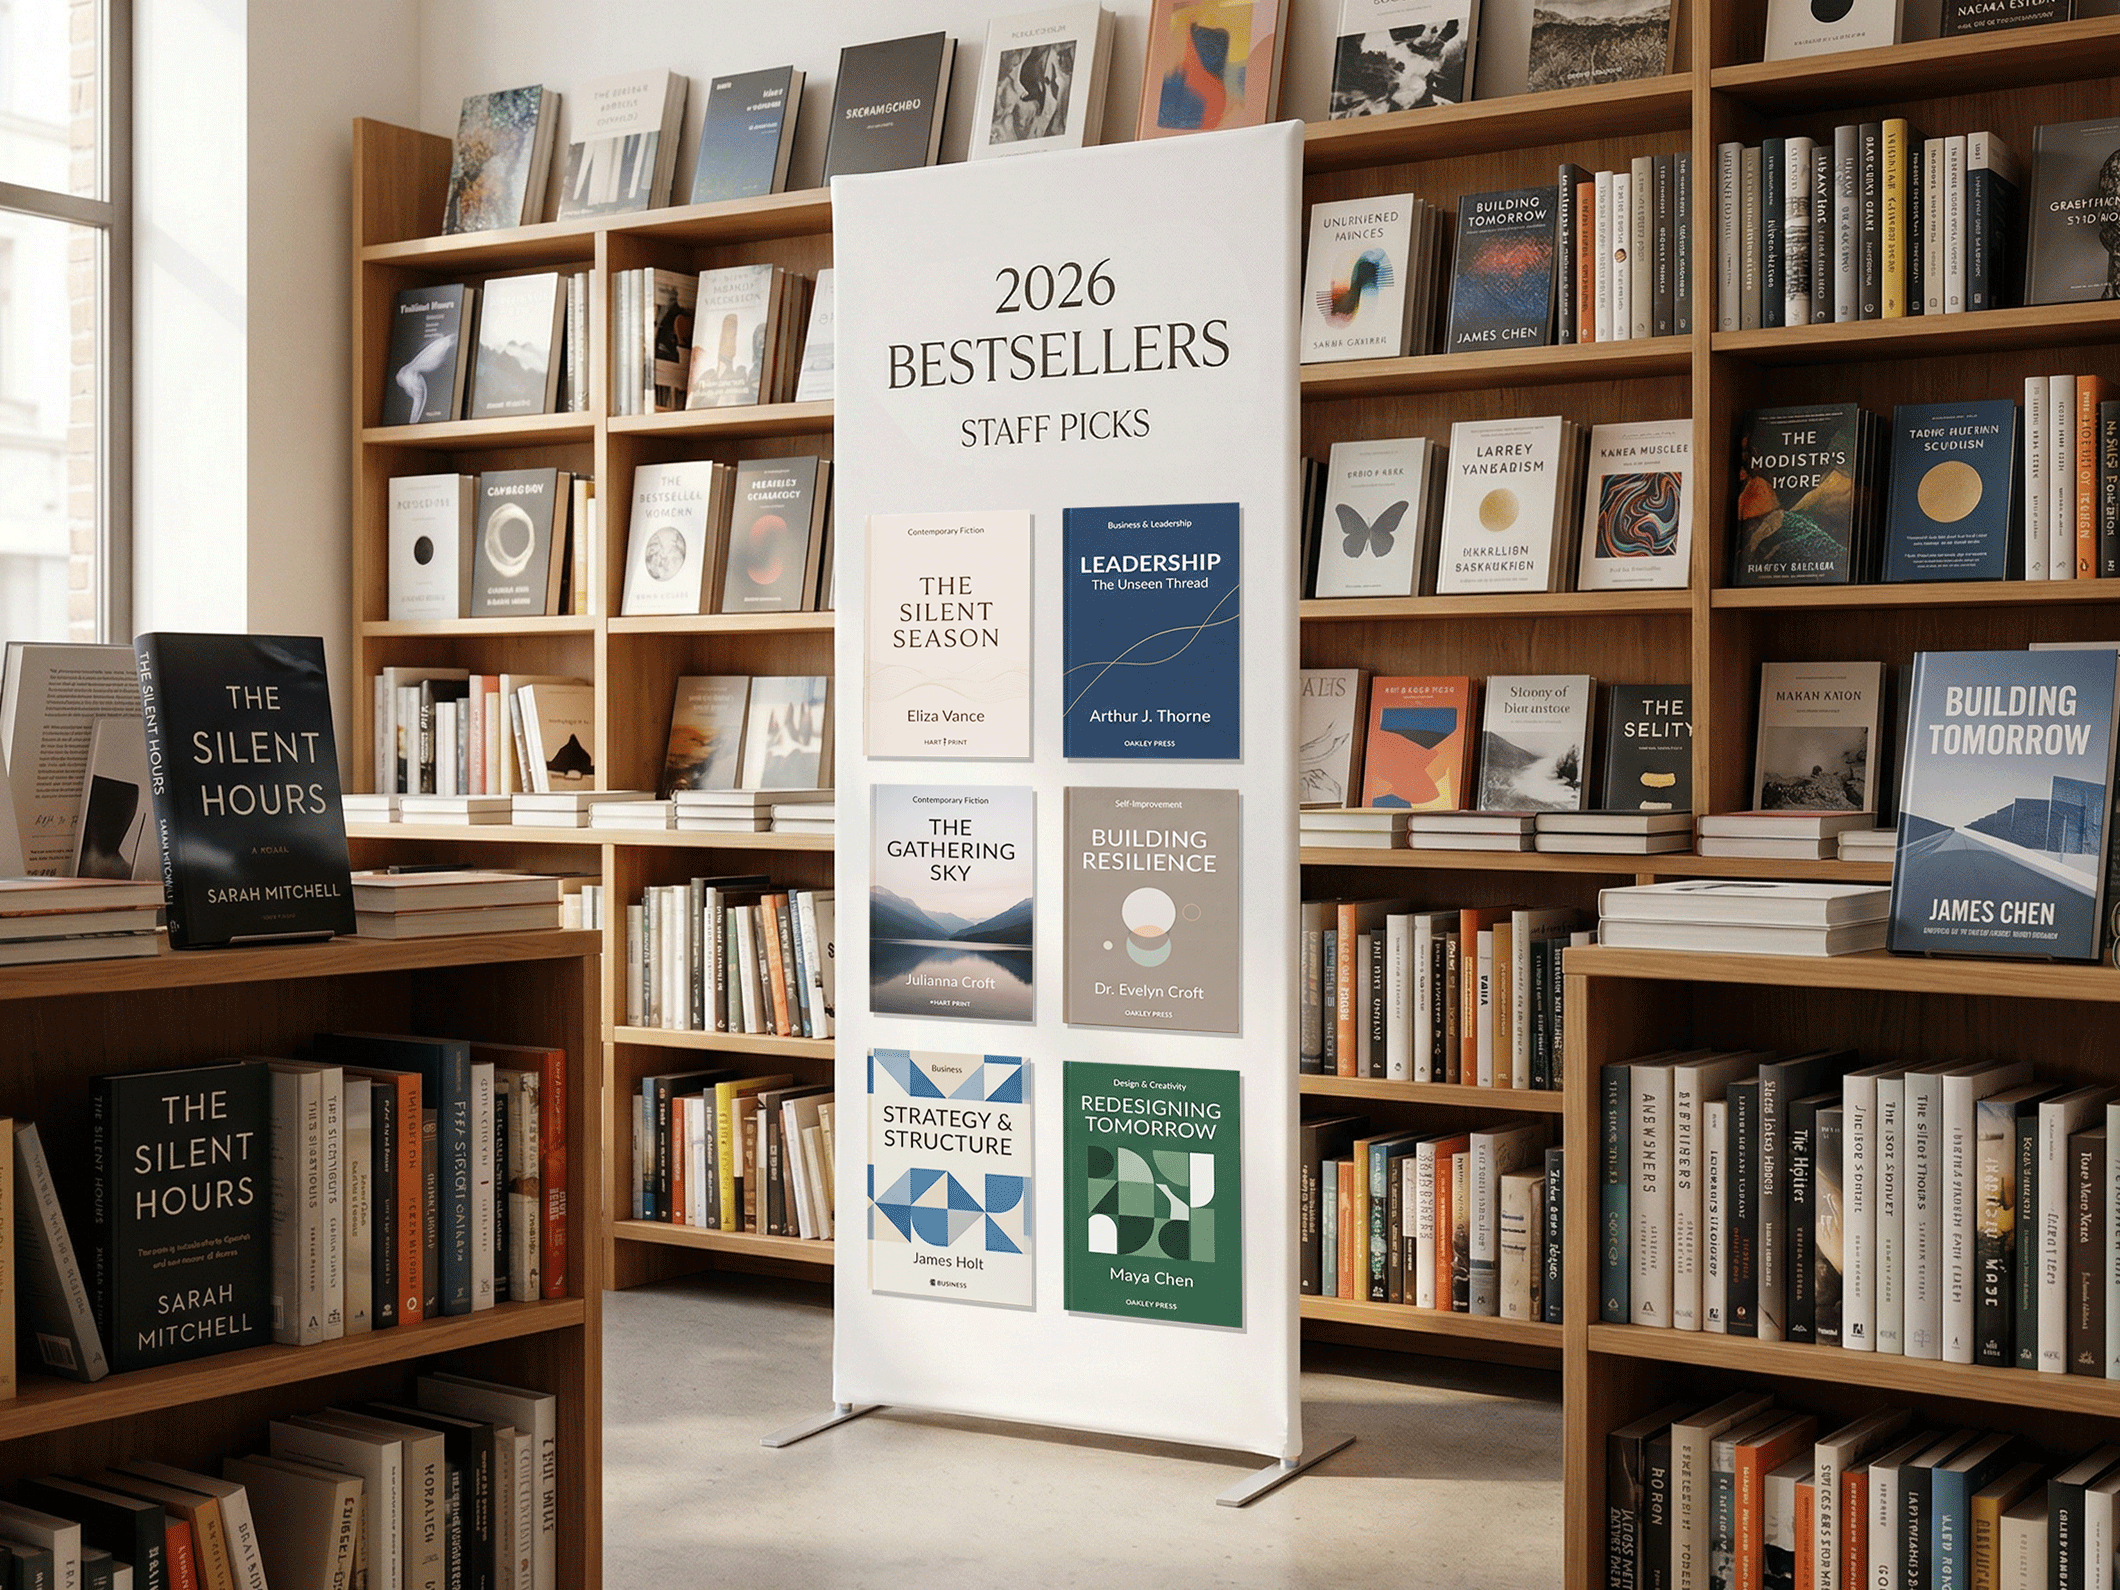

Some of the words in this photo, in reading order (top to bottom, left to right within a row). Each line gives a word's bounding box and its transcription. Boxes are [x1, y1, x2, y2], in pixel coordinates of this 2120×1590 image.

[1476, 196, 1540, 213] BUILDING
[1468, 209, 1547, 227] TOMORROW
[995, 257, 1116, 315] 2026
[1457, 329, 1497, 344] JAMES
[1501, 326, 1538, 339] CHEN
[888, 319, 1230, 390] BESTSELLERS
[961, 414, 1051, 448] STAFF
[1060, 408, 1151, 442] PICKS
[1782, 431, 1817, 446] THE
[1476, 443, 1533, 458] LARREY
[907, 527, 958, 536] Contemporary
[959, 526, 985, 534] Fiction
[1107, 521, 1141, 530] Business
[1142, 520, 1149, 528] &
[1150, 519, 1192, 529] Leadership
[1080, 553, 1221, 574] LEADERSHIP
[919, 576, 973, 595] THE
[1092, 579, 1114, 590] The
[1117, 578, 1163, 590] Unseen
[1165, 577, 1209, 589] Thread
[899, 602, 994, 622] SILENT
[893, 628, 999, 648] SEASON
[139, 650, 152, 682] THE
[225, 685, 281, 711] THE
[1555, 685, 1571, 698] of
[1776, 691, 1820, 701] MAKAN
[1945, 685, 2077, 717] BUILDING
[142, 685, 159, 736] SILENT
[907, 709, 939, 723] Eliza
[942, 710, 985, 723] Vance
[1089, 709, 1138, 723] Arthur
[1141, 710, 1152, 723] J.
[1156, 709, 1211, 723] Thorne
[1642, 700, 1683, 716] THE
[1624, 721, 1693, 738] SELITY
[1929, 724, 2091, 755] TOMORROW
[192, 730, 320, 764] SILENT
[149, 738, 165, 796] HOURS
[201, 783, 327, 816] HOURS
[912, 795, 963, 805] Contemporary
[964, 796, 989, 804] Fiction
[1114, 799, 1183, 809] Self-Improvement
[929, 818, 972, 836] THE
[1091, 829, 1207, 849] BUILDING
[887, 840, 1015, 860] GATHERING
[1082, 852, 1217, 873] RESILIENCE
[930, 864, 972, 882] SKY
[207, 887, 261, 904] SARAH
[265, 883, 341, 900] MITCHELL
[1929, 898, 1994, 923] JAMES
[2000, 900, 2055, 926] CHEN
[905, 973, 958, 988] Julianna
[961, 976, 996, 990] Croft
[1094, 982, 1115, 995] Dr.
[1119, 983, 1164, 999] Evelyn
[1167, 985, 1204, 1000] Croft
[952, 1000, 971, 1008] PRINT
[1124, 1009, 1151, 1018] OAKLEY
[1152, 1010, 1173, 1019] PRESS
[931, 1064, 963, 1074] Business
[1113, 1079, 1140, 1089] Design
[1149, 1081, 1187, 1092] Creativity
[161, 1090, 228, 1125] THE
[1081, 1095, 1221, 1120] REDESIGNING
[883, 1105, 992, 1130] STRATEGY
[997, 1113, 1013, 1132] &
[1085, 1115, 1217, 1140] TOMORROW
[884, 1130, 1012, 1156] STRUCTURE
[134, 1132, 254, 1175] SILENT
[136, 1176, 254, 1220] HOURS
[913, 1252, 952, 1267] James
[956, 1255, 984, 1270] Holt
[936, 1280, 967, 1289] BUSINESS
[1110, 1267, 1150, 1284] Maya
[1154, 1271, 1194, 1288] Chen
[157, 1283, 233, 1315] SARAH
[1125, 1298, 1153, 1308] OAKLEY
[1155, 1301, 1177, 1310] PRESS
[138, 1313, 253, 1351] MITCHELL
